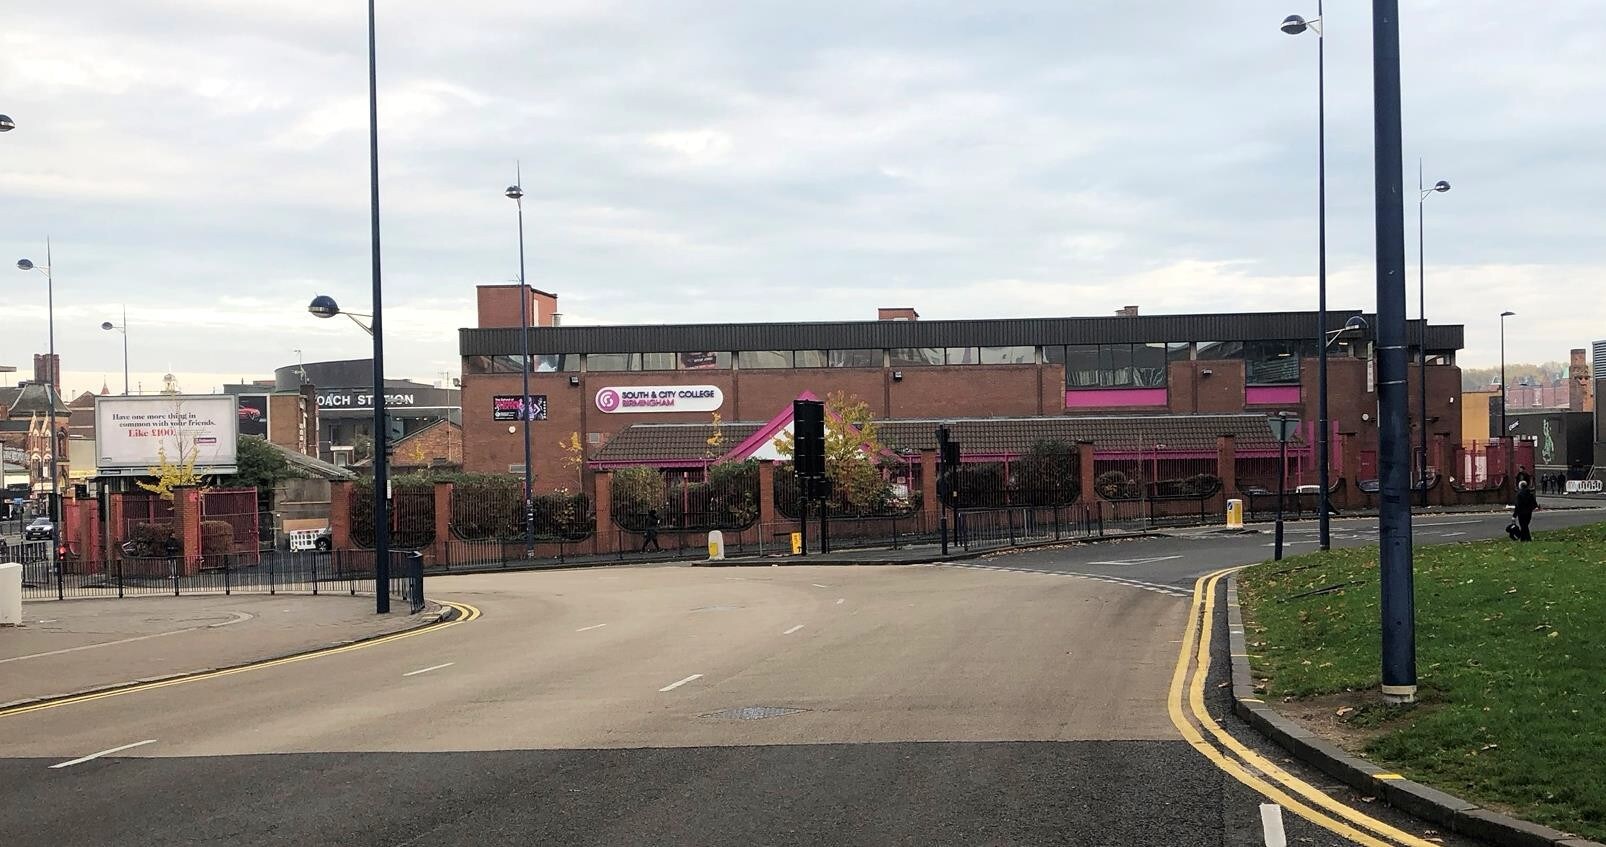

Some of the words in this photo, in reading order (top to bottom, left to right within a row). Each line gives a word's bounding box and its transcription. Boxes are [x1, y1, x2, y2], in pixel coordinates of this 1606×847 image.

[621, 391, 649, 399] SOUTH
[658, 391, 676, 399] CITY
[678, 390, 715, 398] COLLEGE
[317, 395, 350, 406] OACH
[357, 394, 414, 405] STTION
[622, 399, 675, 407] BIRMINGHAM
[168, 412, 187, 421] thing
[128, 429, 149, 437] Like
